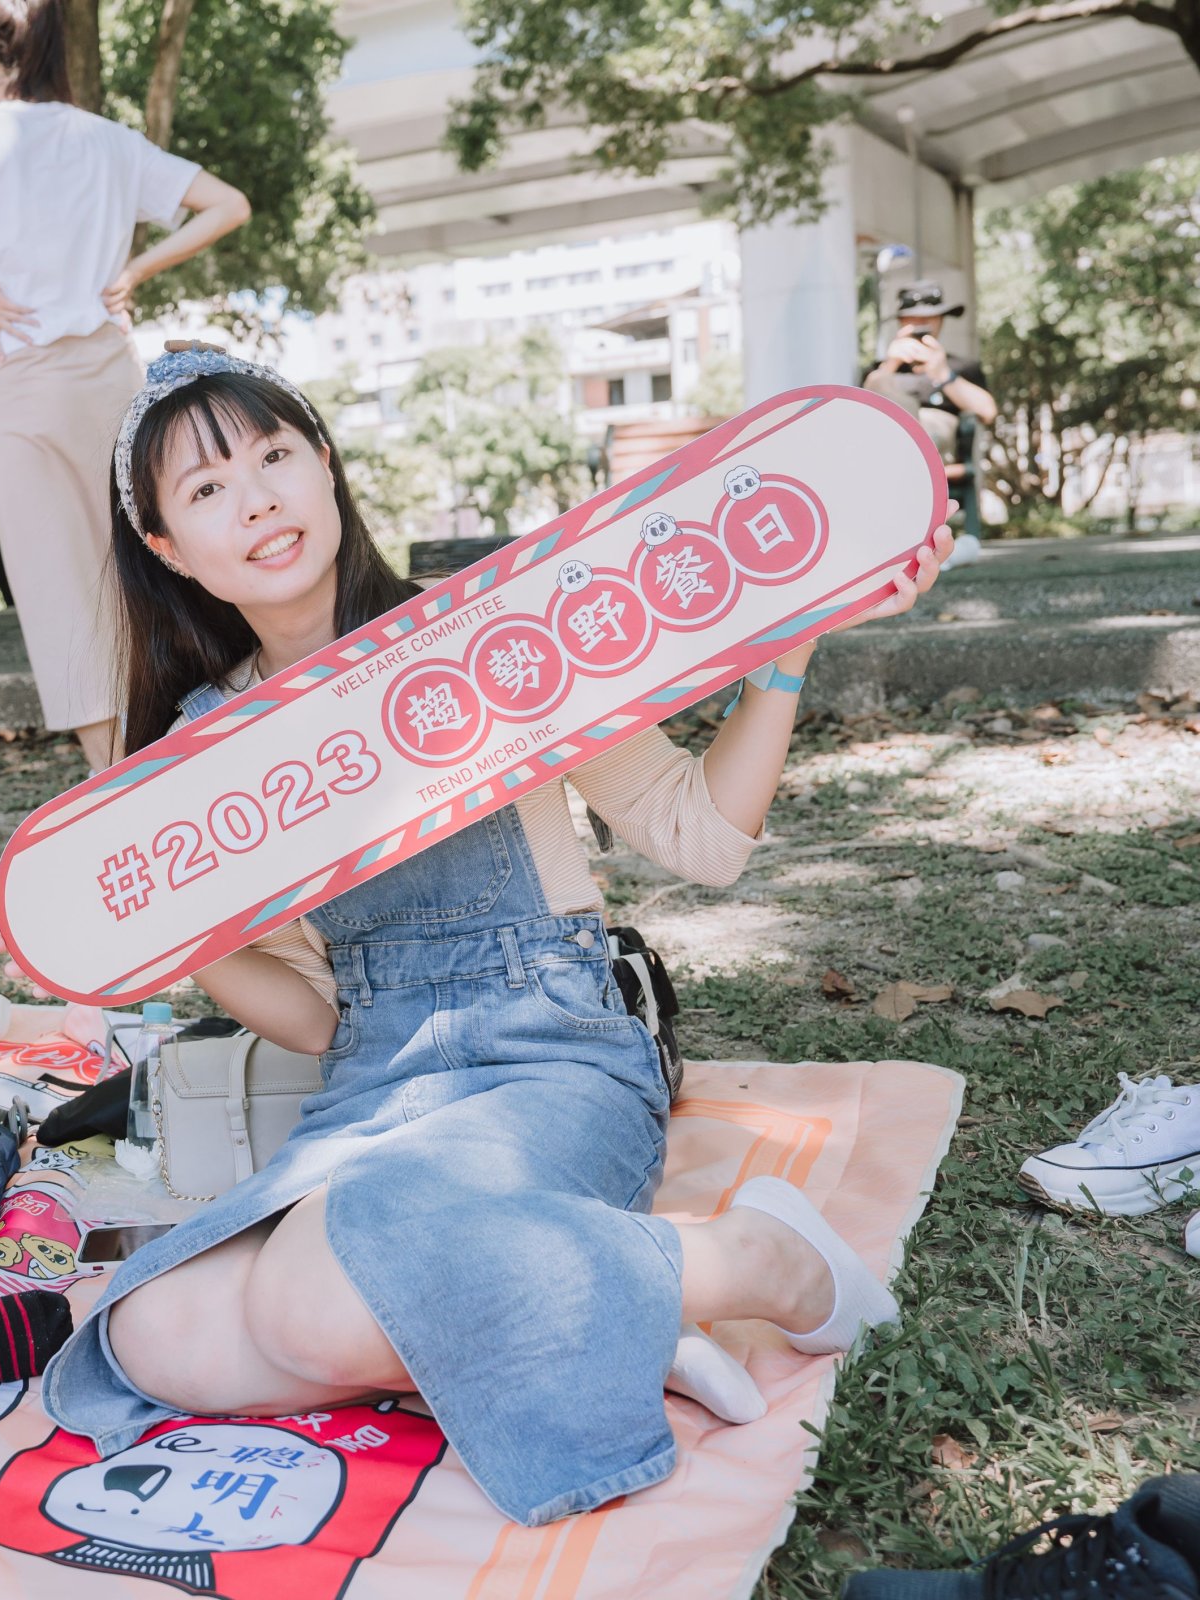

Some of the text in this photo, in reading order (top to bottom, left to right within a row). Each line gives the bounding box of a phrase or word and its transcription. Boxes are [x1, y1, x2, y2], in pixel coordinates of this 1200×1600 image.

[331, 594, 506, 699] WELFARE COMMITTEE
[416, 723, 560, 804] TREND MICRO Inc.
[96, 729, 382, 922] #2023
